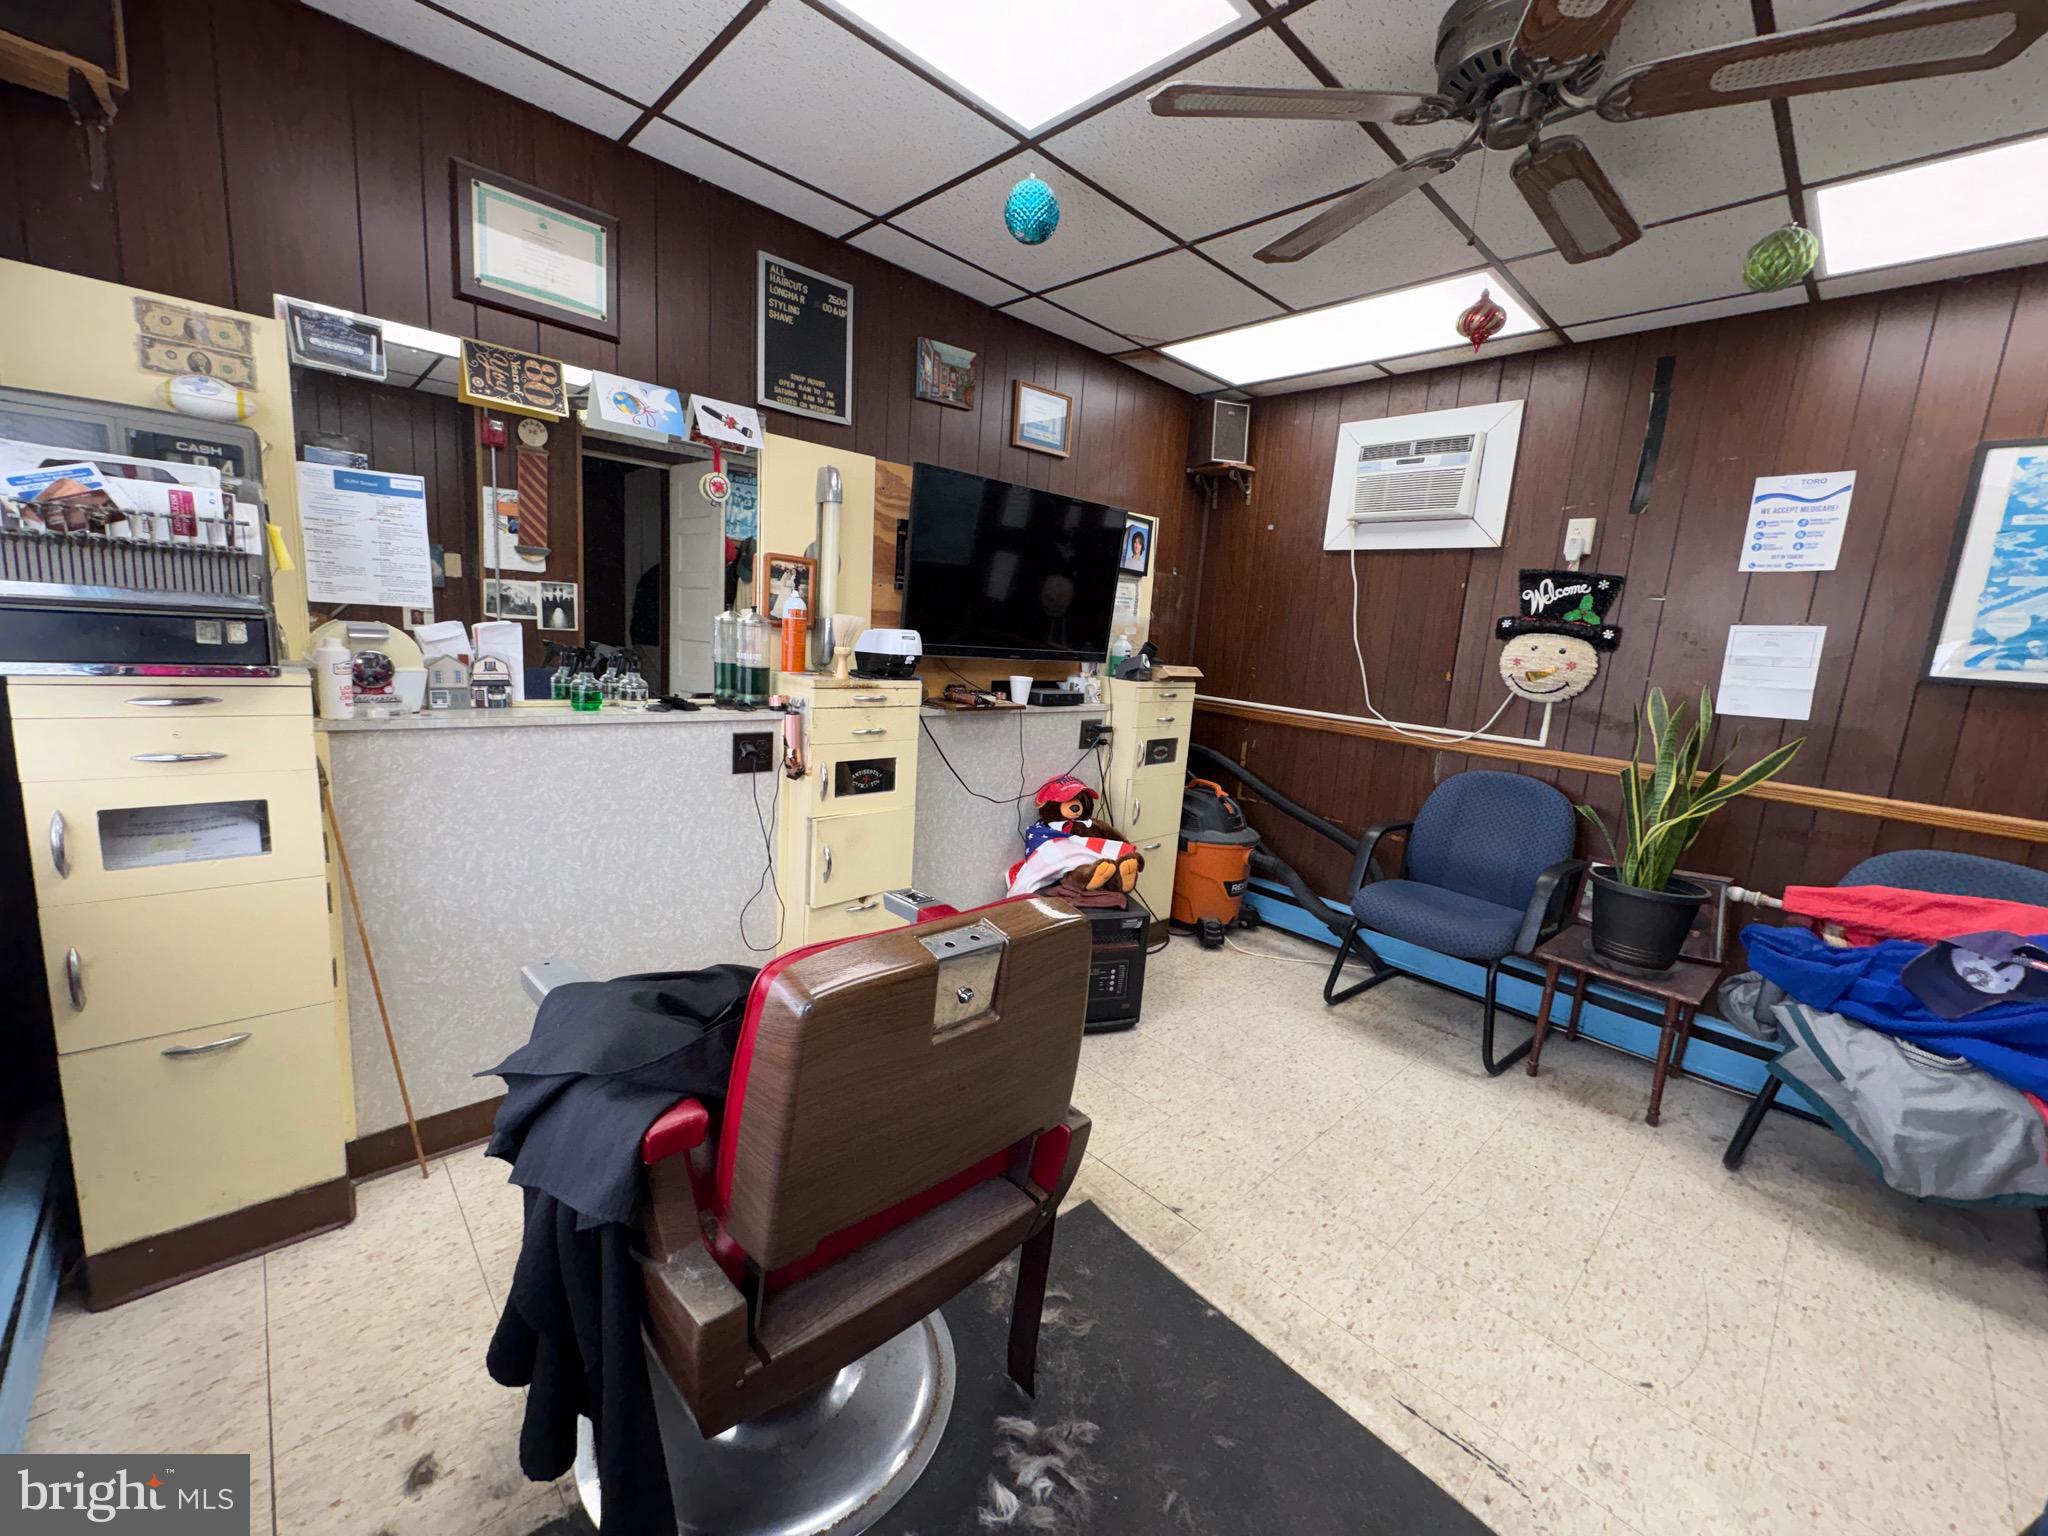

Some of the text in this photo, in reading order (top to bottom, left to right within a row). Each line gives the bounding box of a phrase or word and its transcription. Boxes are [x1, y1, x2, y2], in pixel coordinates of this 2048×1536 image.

[769, 264, 786, 278] ALL
[769, 272, 809, 295] HAIRCUTS
[768, 298, 801, 316] STYLING
[768, 310, 795, 325] SHAVE
[523, 360, 558, 406] 80
[176, 442, 223, 456] CASH
[1522, 578, 1592, 616] Welcome
